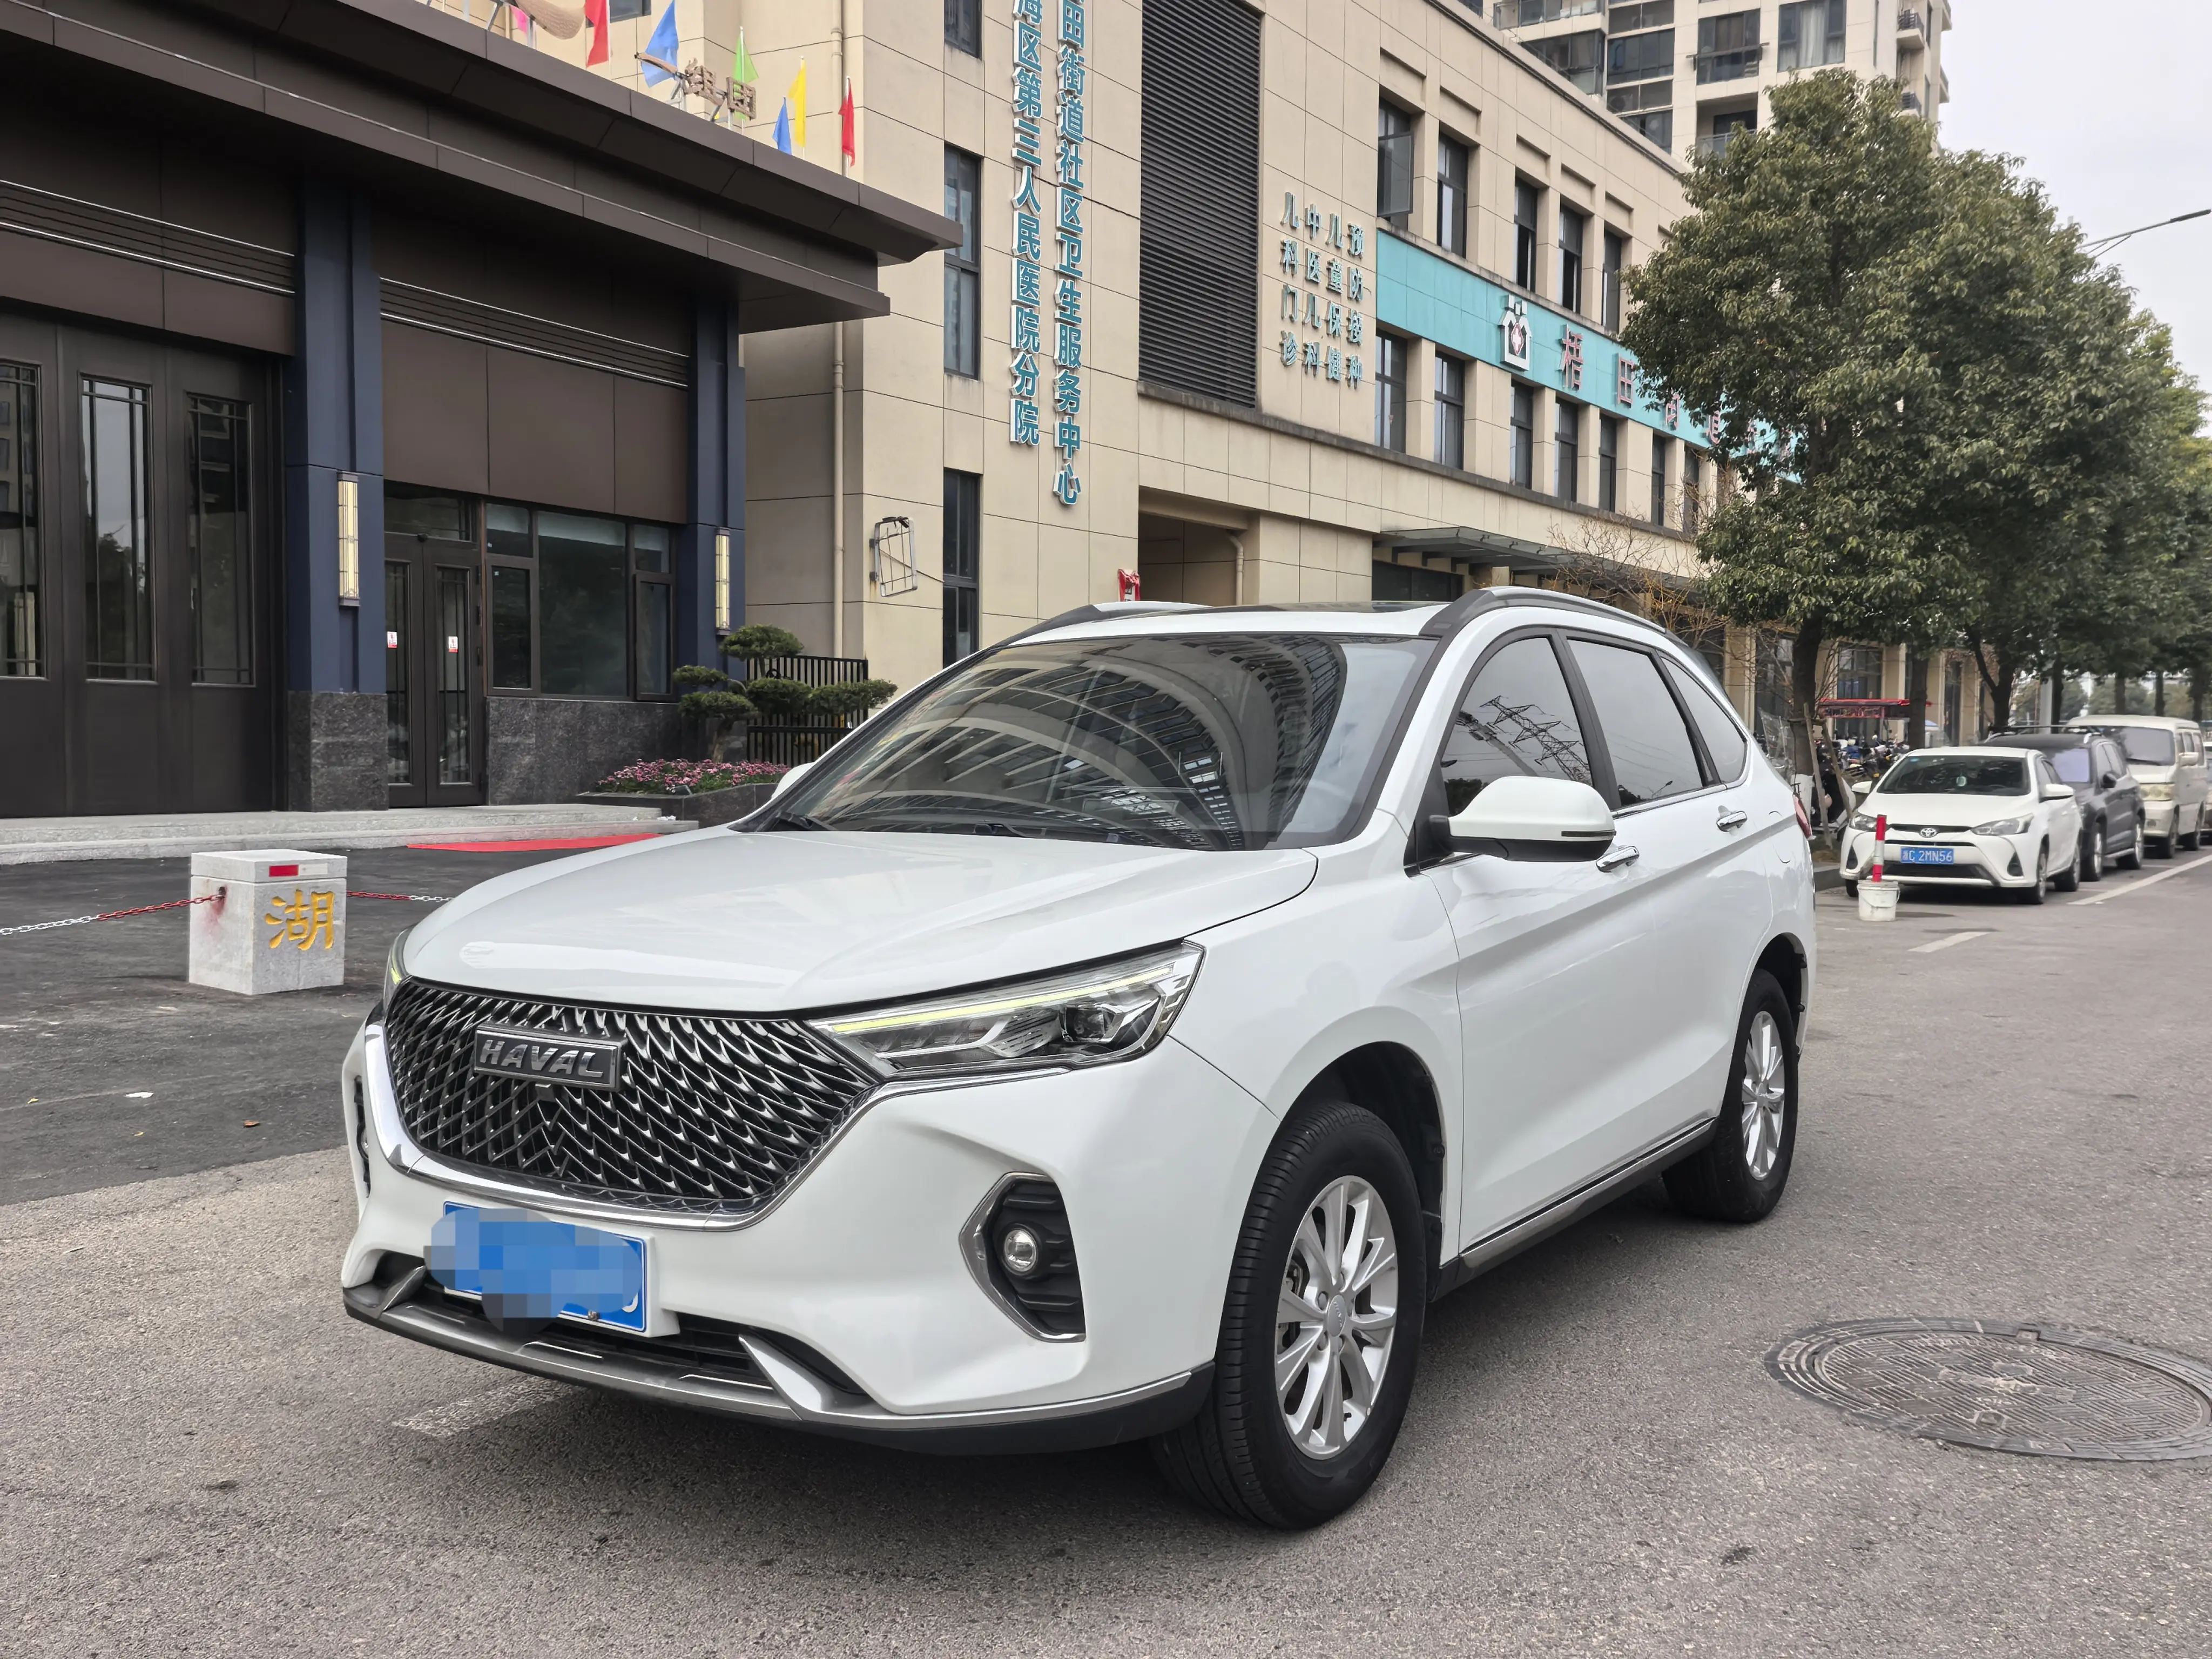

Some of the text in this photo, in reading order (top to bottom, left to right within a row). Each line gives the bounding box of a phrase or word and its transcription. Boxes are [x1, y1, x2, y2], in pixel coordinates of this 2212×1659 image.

[1053, 0, 1085, 505] 田街道社区卫生服务中心
[1280, 192, 1299, 366] 儿科门诊
[1303, 204, 1321, 376] 中医儿科
[1325, 213, 1343, 382] 儿童保健
[1346, 223, 1365, 389] 预防接种
[264, 889, 335, 950] 湖
[1919, 851, 1952, 862] 2MN56
[480, 1040, 603, 1077] HAVAL
